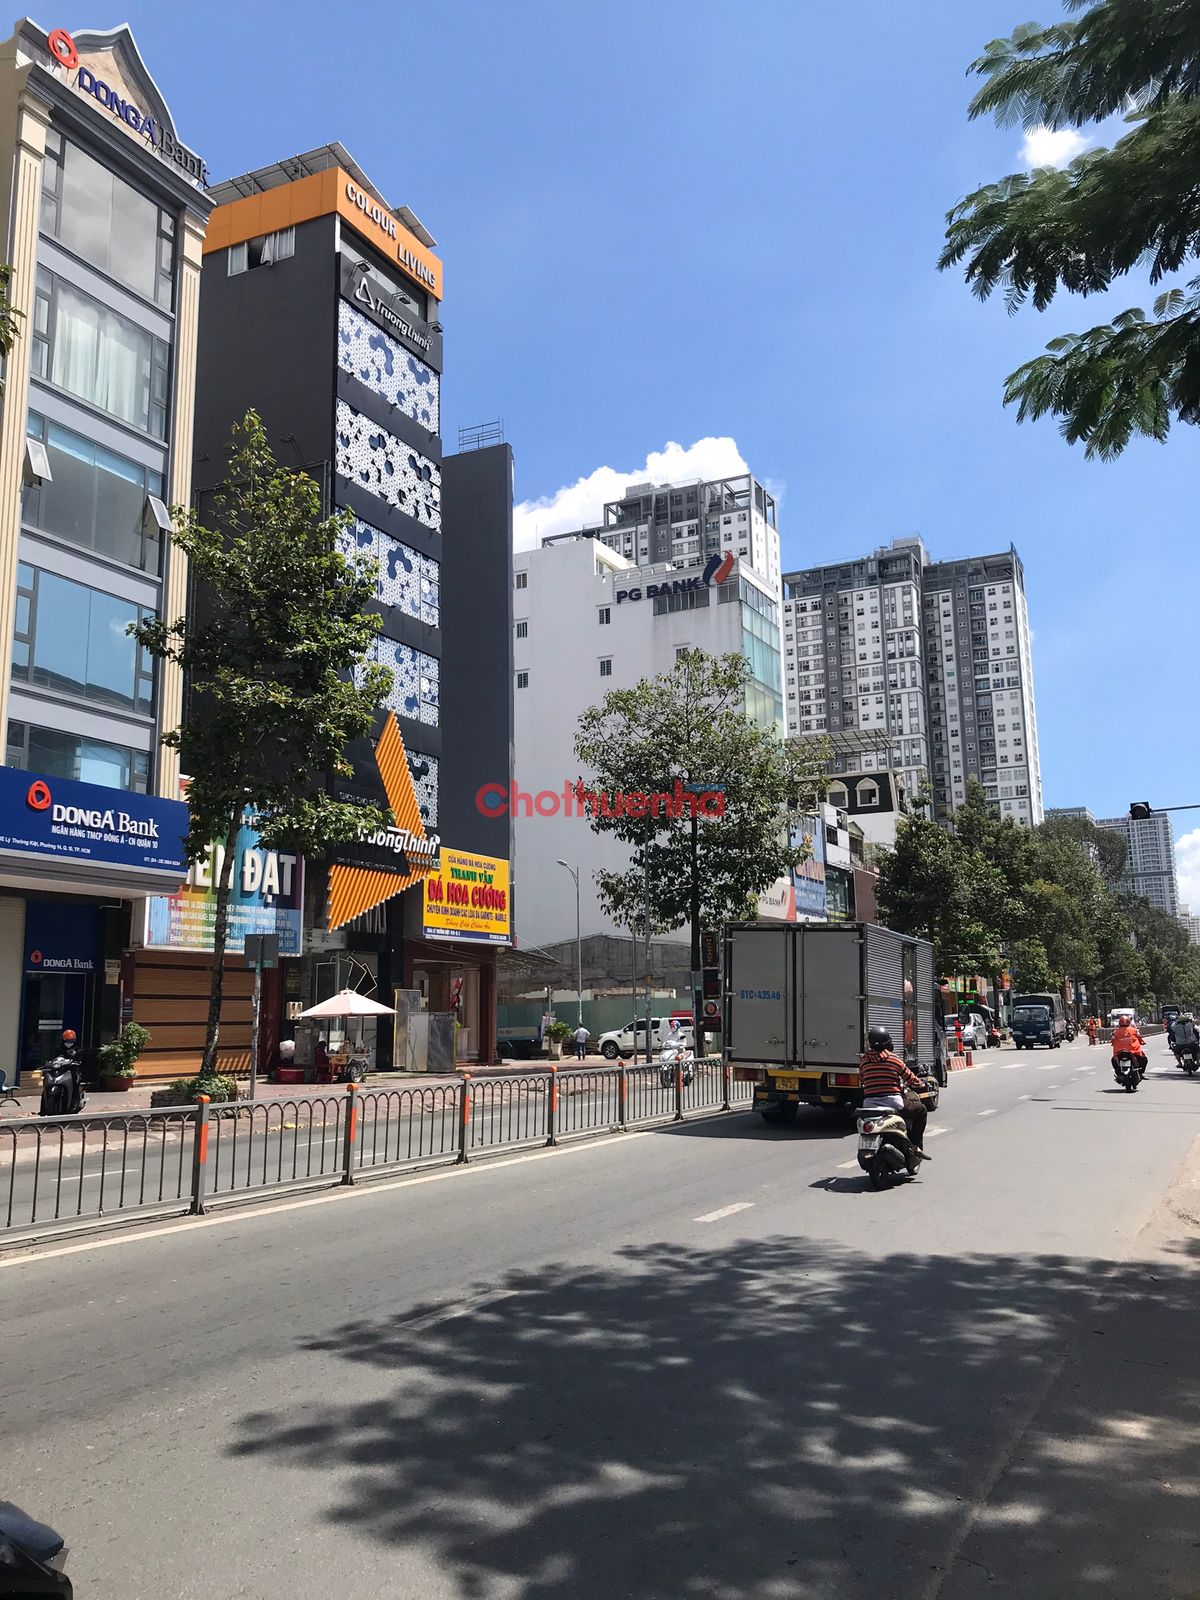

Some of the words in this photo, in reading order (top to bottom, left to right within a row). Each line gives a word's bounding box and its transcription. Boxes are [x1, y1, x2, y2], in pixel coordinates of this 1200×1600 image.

[159, 126, 210, 188] Bank
[347, 182, 396, 240] COLOUR
[398, 243, 435, 289] LIVING
[617, 588, 641, 603] PG
[647, 577, 700, 598] BANK
[52, 825, 69, 835] NGÂN
[70, 827, 86, 838] HÀNG
[87, 830, 103, 840] TMCP
[103, 833, 119, 843] ĐÔNG
[120, 835, 125, 844] Á
[128, 837, 136, 845] CN
[136, 838, 151, 848] QUẬN
[152, 841, 158, 849] 10
[118, 812, 159, 838] Bank
[243, 848, 296, 903] ĐẠT
[451, 866, 477, 882] THANH
[428, 875, 443, 903] ĐÁ
[447, 882, 469, 907] HOA
[74, 960, 93, 969] Bank
